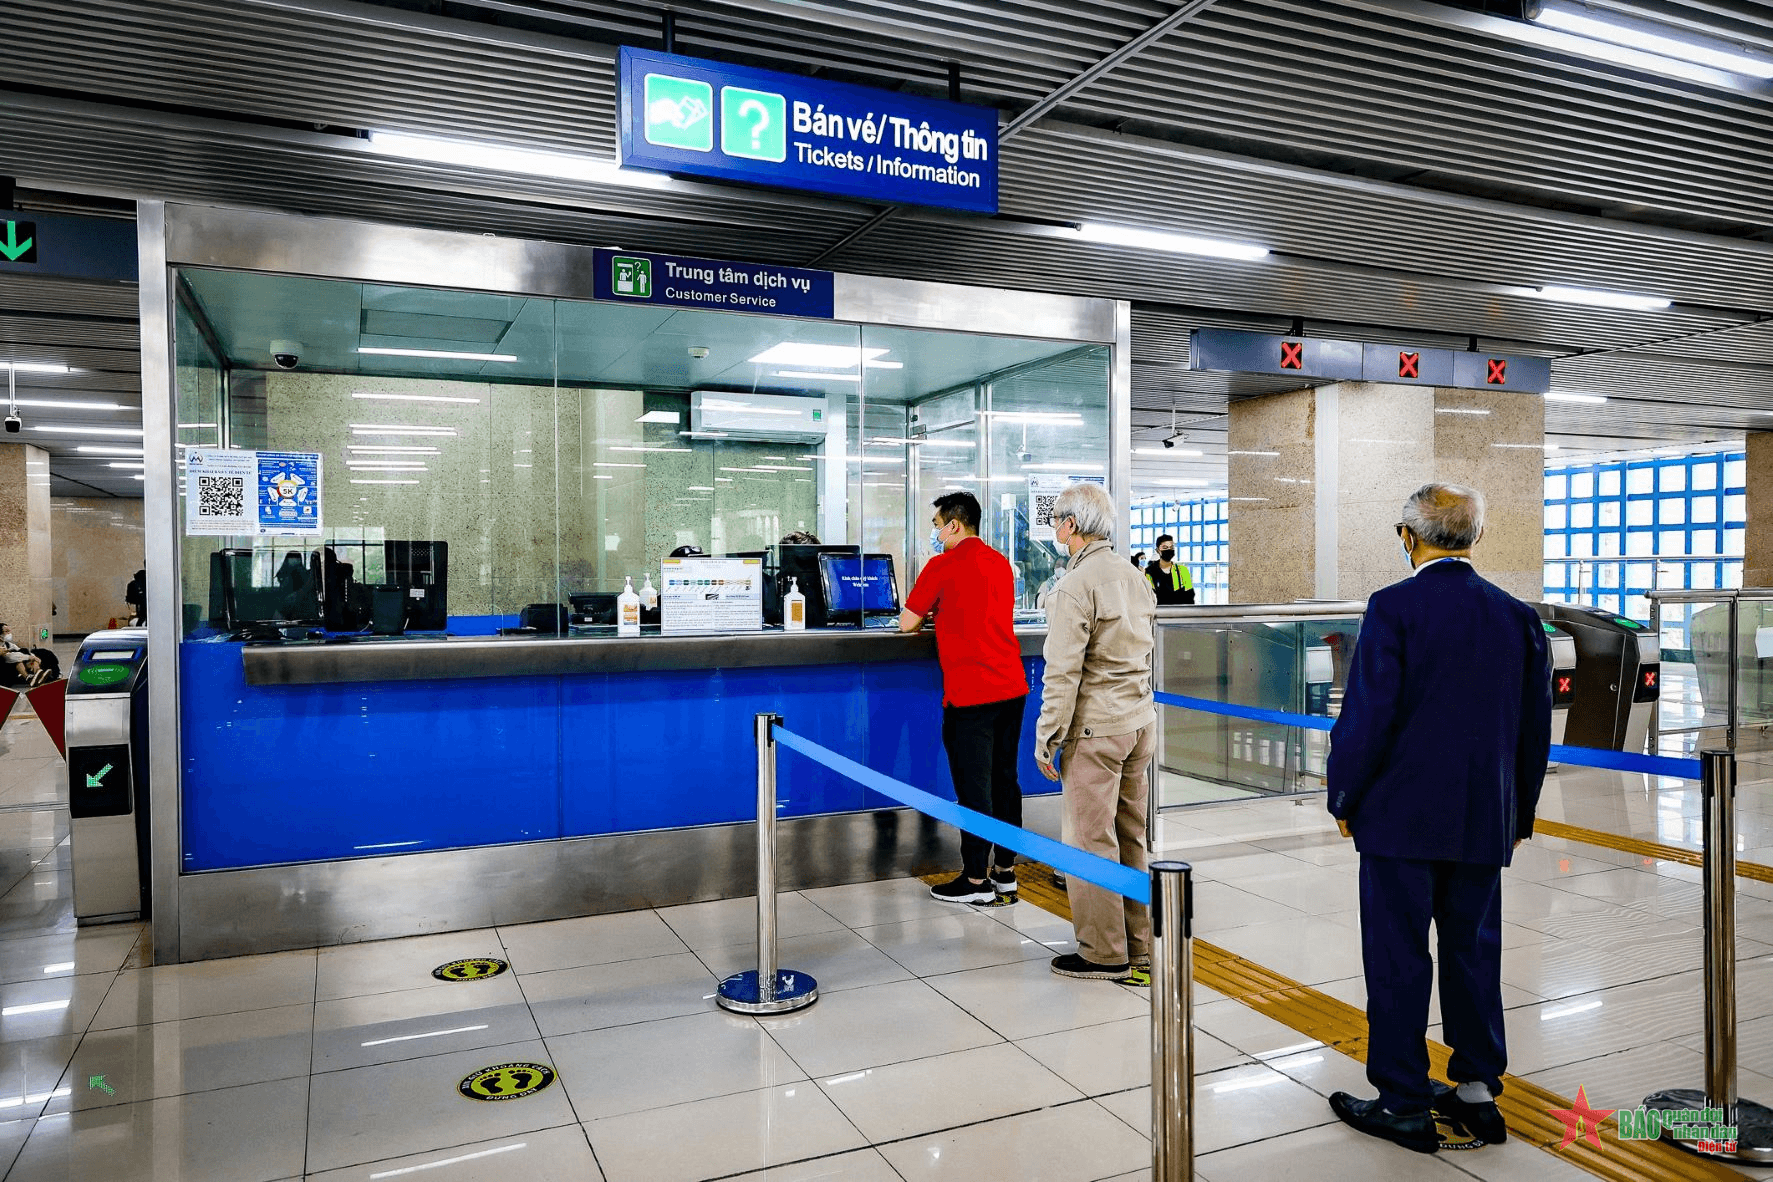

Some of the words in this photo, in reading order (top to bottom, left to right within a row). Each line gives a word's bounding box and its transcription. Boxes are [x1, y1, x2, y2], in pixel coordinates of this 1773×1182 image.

[793, 100, 844, 139] Bán
[846, 112, 888, 145] vé/
[889, 116, 959, 164] Thông
[961, 129, 988, 161] tin
[793, 142, 864, 171] Tickets
[876, 154, 980, 188] Information
[665, 262, 714, 285] Trung
[718, 267, 749, 285] tâm
[753, 271, 787, 290] dịch
[791, 278, 811, 294] vụ
[665, 287, 727, 303] Customer
[729, 292, 776, 308] Service
